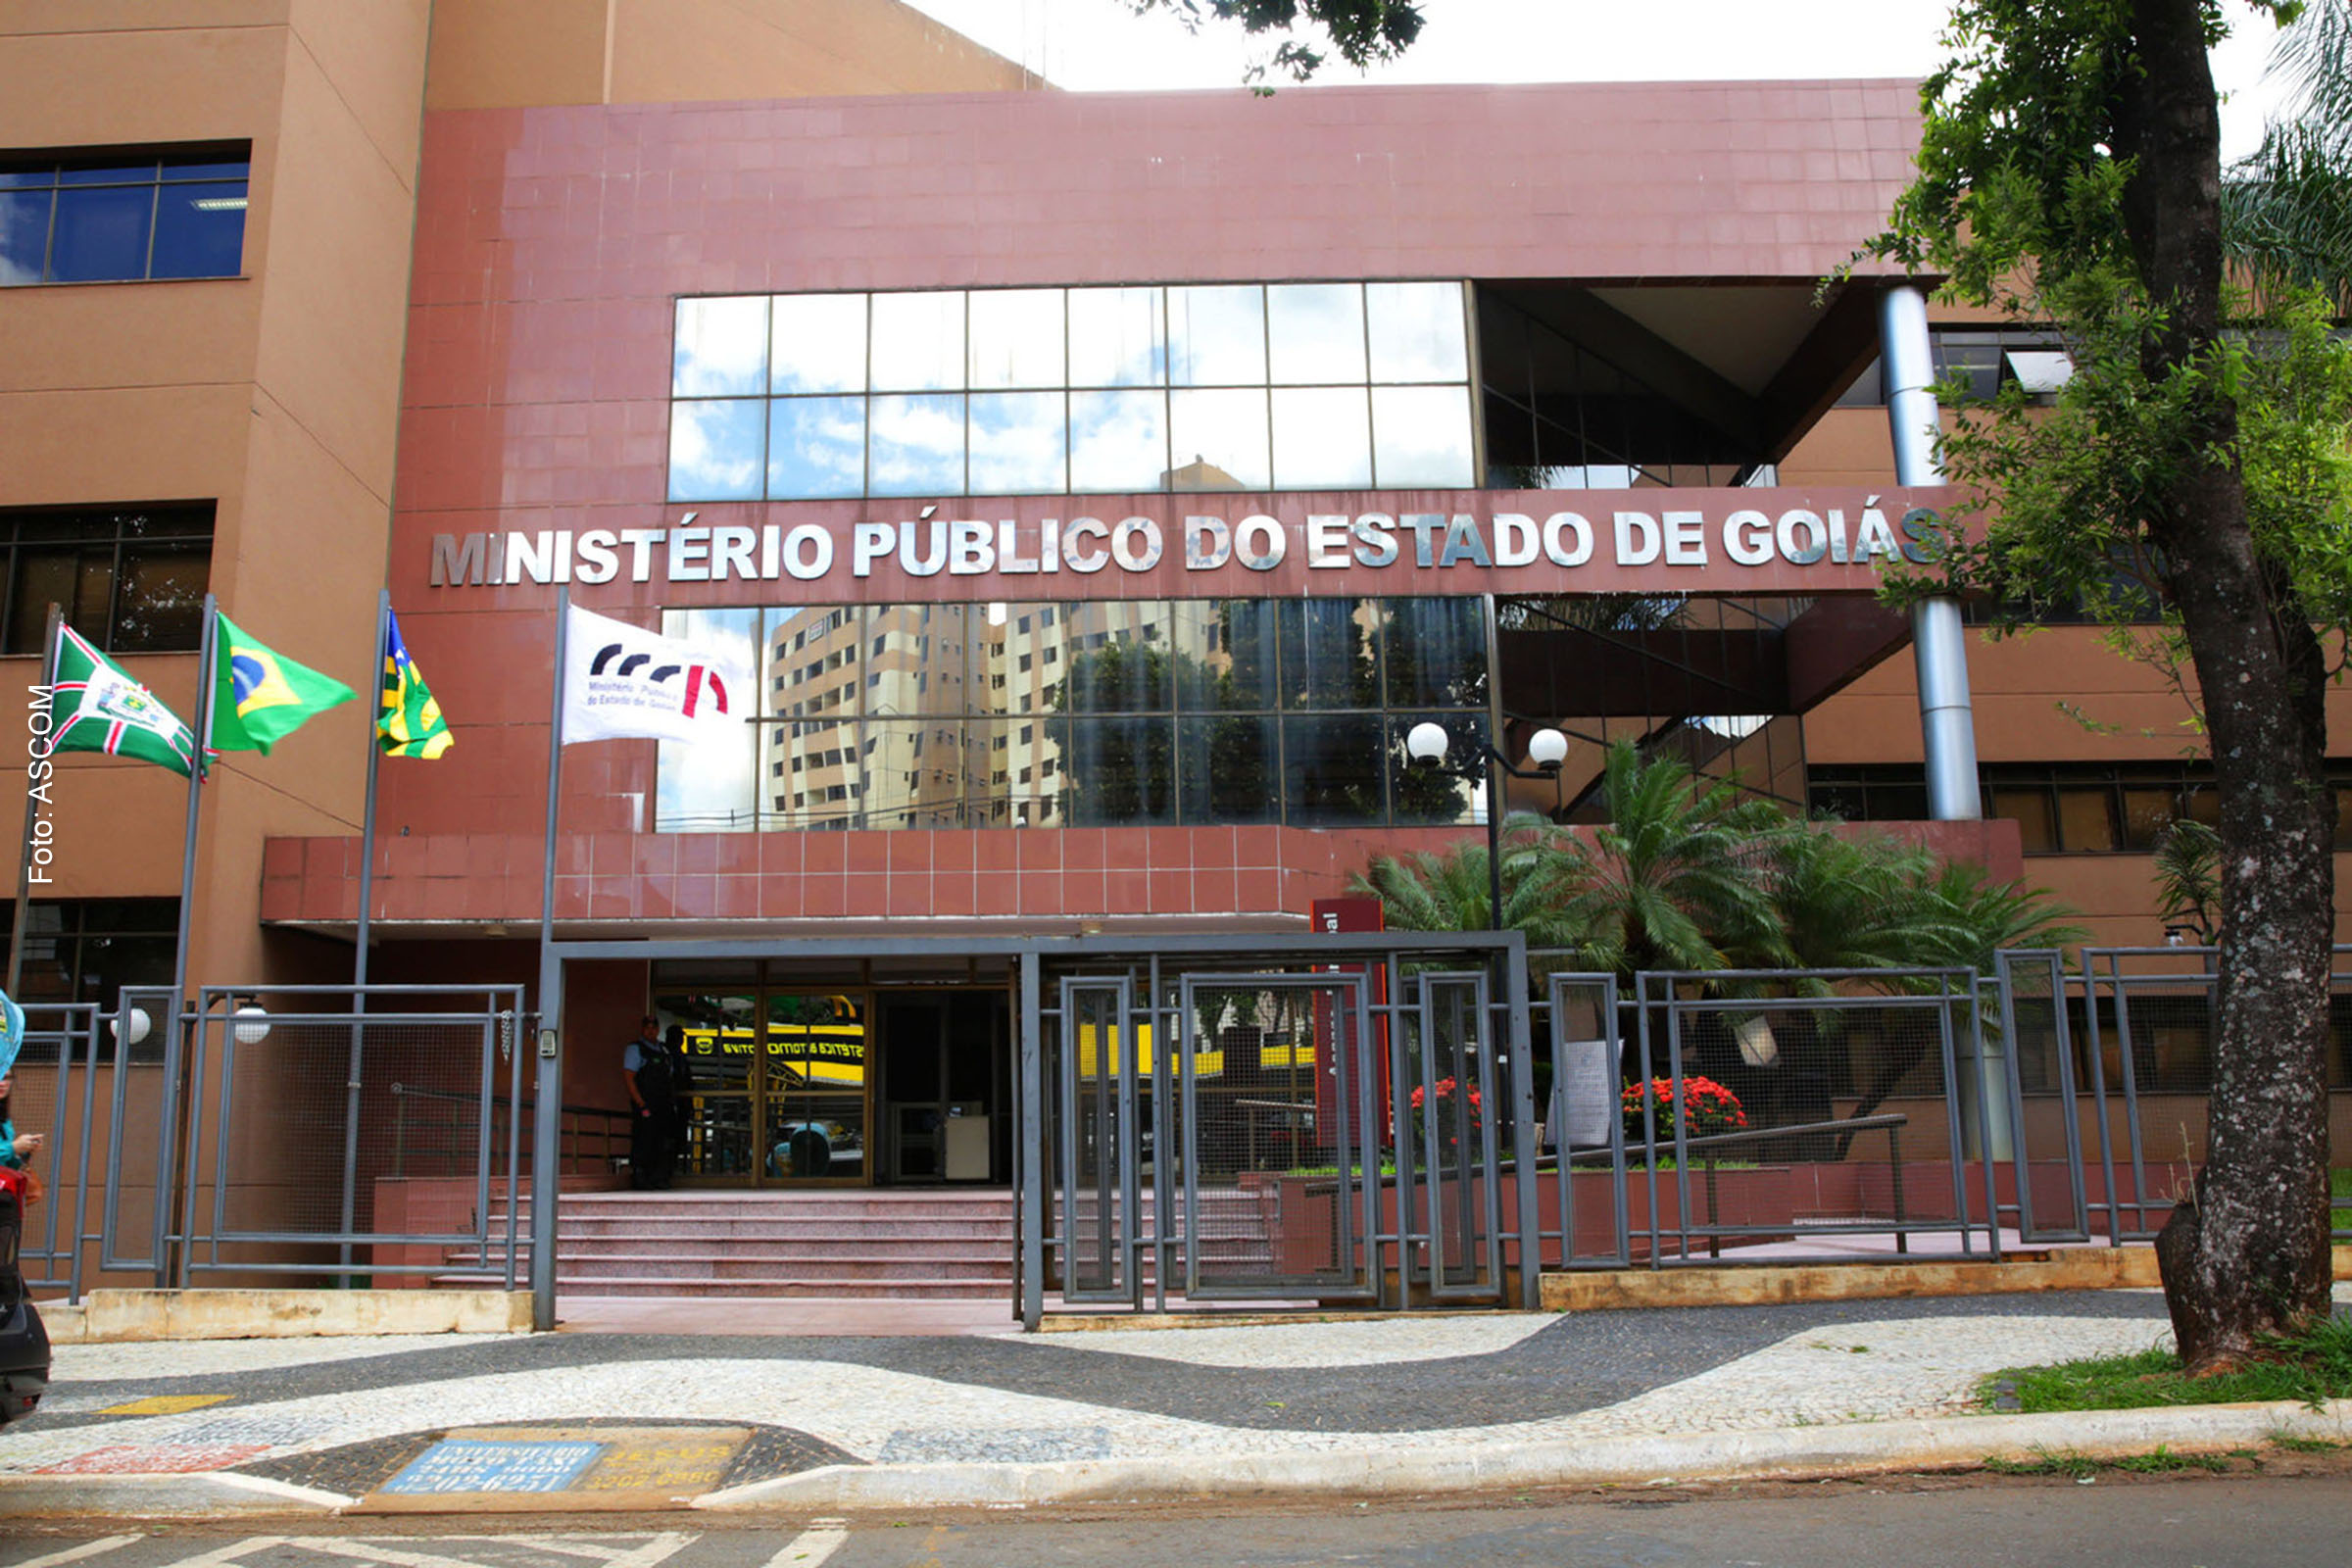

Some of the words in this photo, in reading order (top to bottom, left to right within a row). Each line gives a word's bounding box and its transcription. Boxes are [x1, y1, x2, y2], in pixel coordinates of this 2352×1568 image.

[431, 513, 833, 587] MINISTÉRIO
[853, 506, 1163, 578] PÚBLICO
[1185, 514, 1288, 572] DO
[1307, 511, 1595, 569] ESTADO
[1613, 510, 1708, 567] DE
[1722, 495, 1945, 565] GOIÁS
